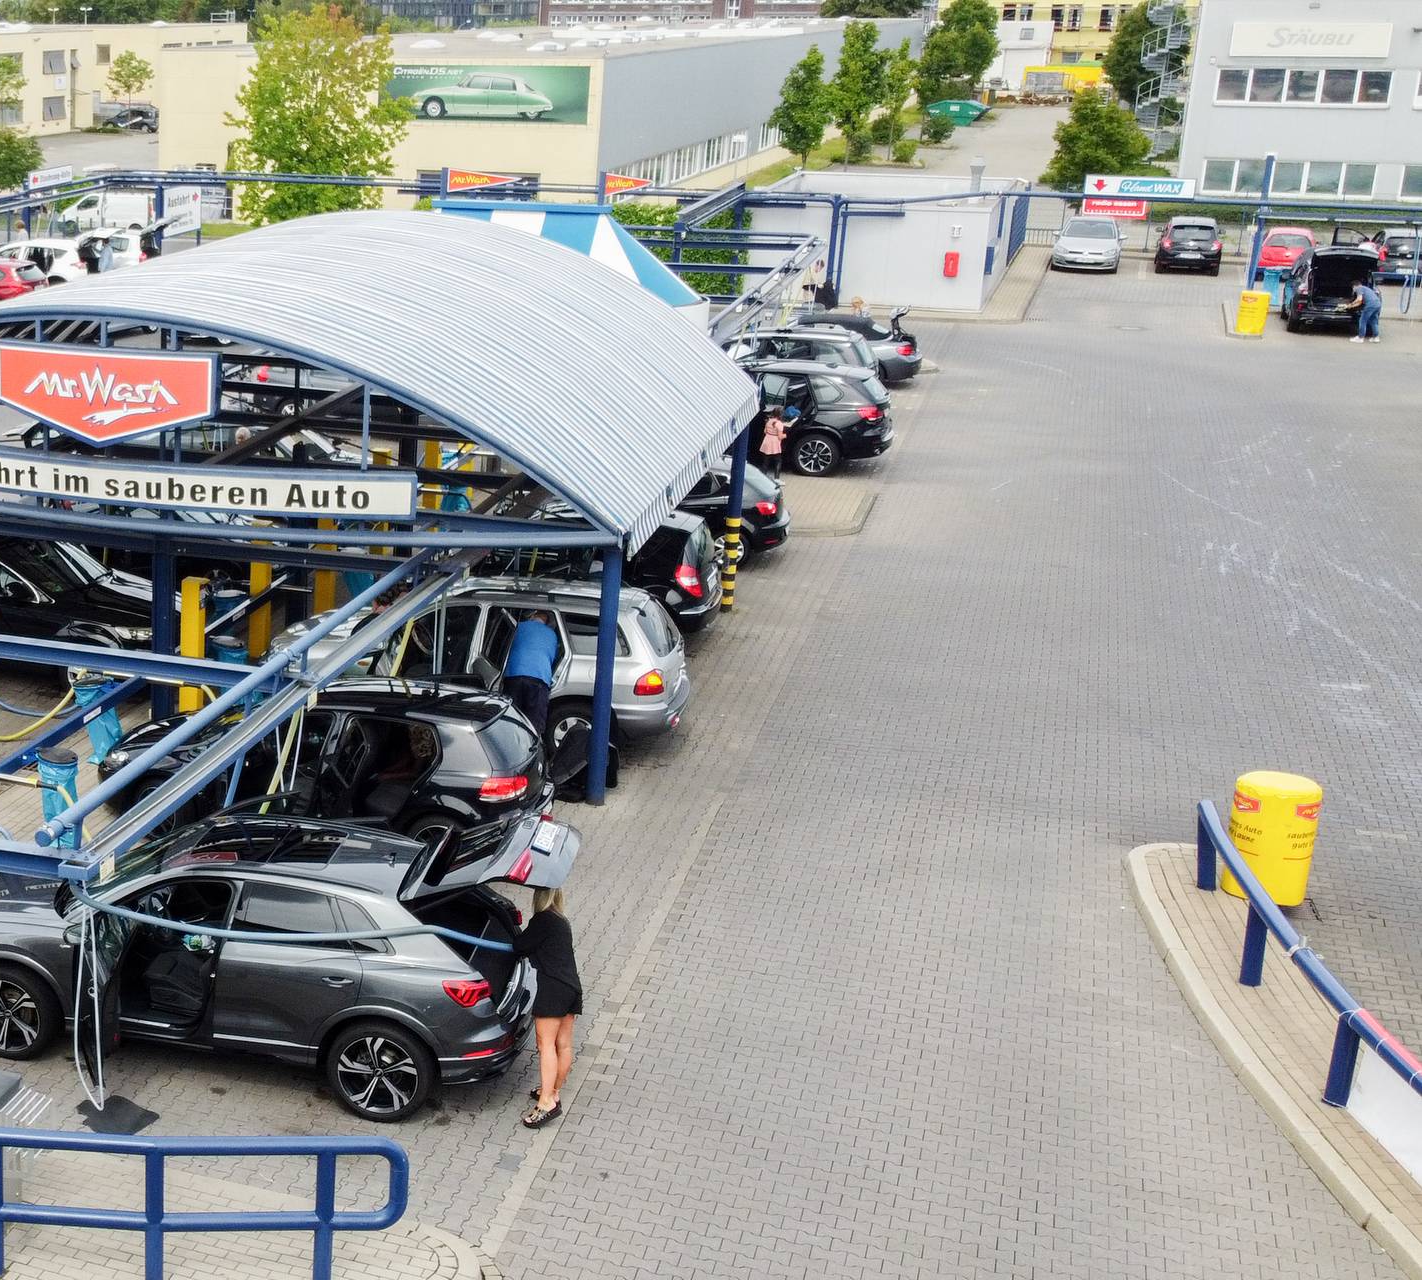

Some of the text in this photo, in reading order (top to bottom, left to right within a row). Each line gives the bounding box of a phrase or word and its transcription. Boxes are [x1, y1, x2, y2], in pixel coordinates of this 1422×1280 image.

[1266, 27, 1355, 48] STÄUBLI
[1153, 183, 1181, 193] WAX
[53, 468, 90, 494] im
[104, 477, 269, 506] sauberen
[284, 483, 371, 509] Auto
